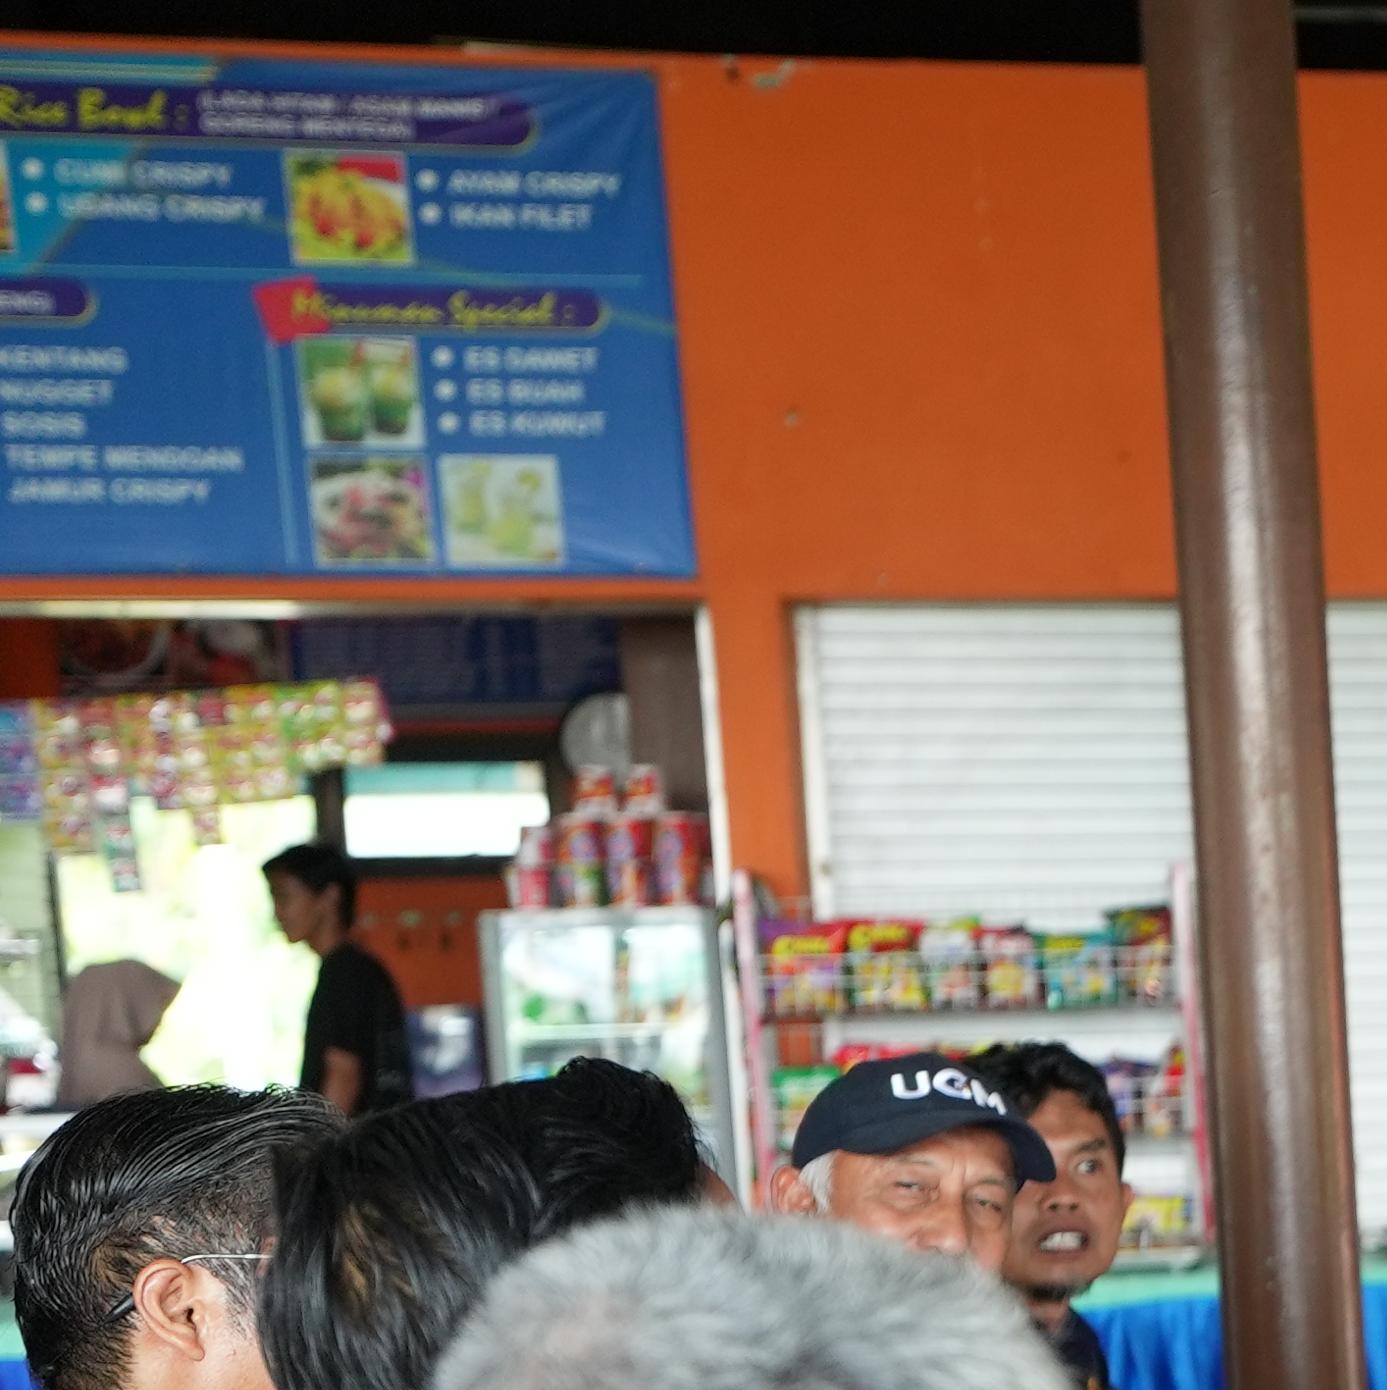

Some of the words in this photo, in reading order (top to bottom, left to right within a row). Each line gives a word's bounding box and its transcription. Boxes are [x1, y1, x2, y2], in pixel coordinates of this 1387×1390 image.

[131, 160, 233, 189] CRISPY
[523, 170, 622, 200] CRISPY
[163, 195, 265, 223] CRISPY
[519, 202, 593, 232] FILET
[109, 478, 212, 506] CRISPY
[889, 1066, 1007, 1116] UGM
